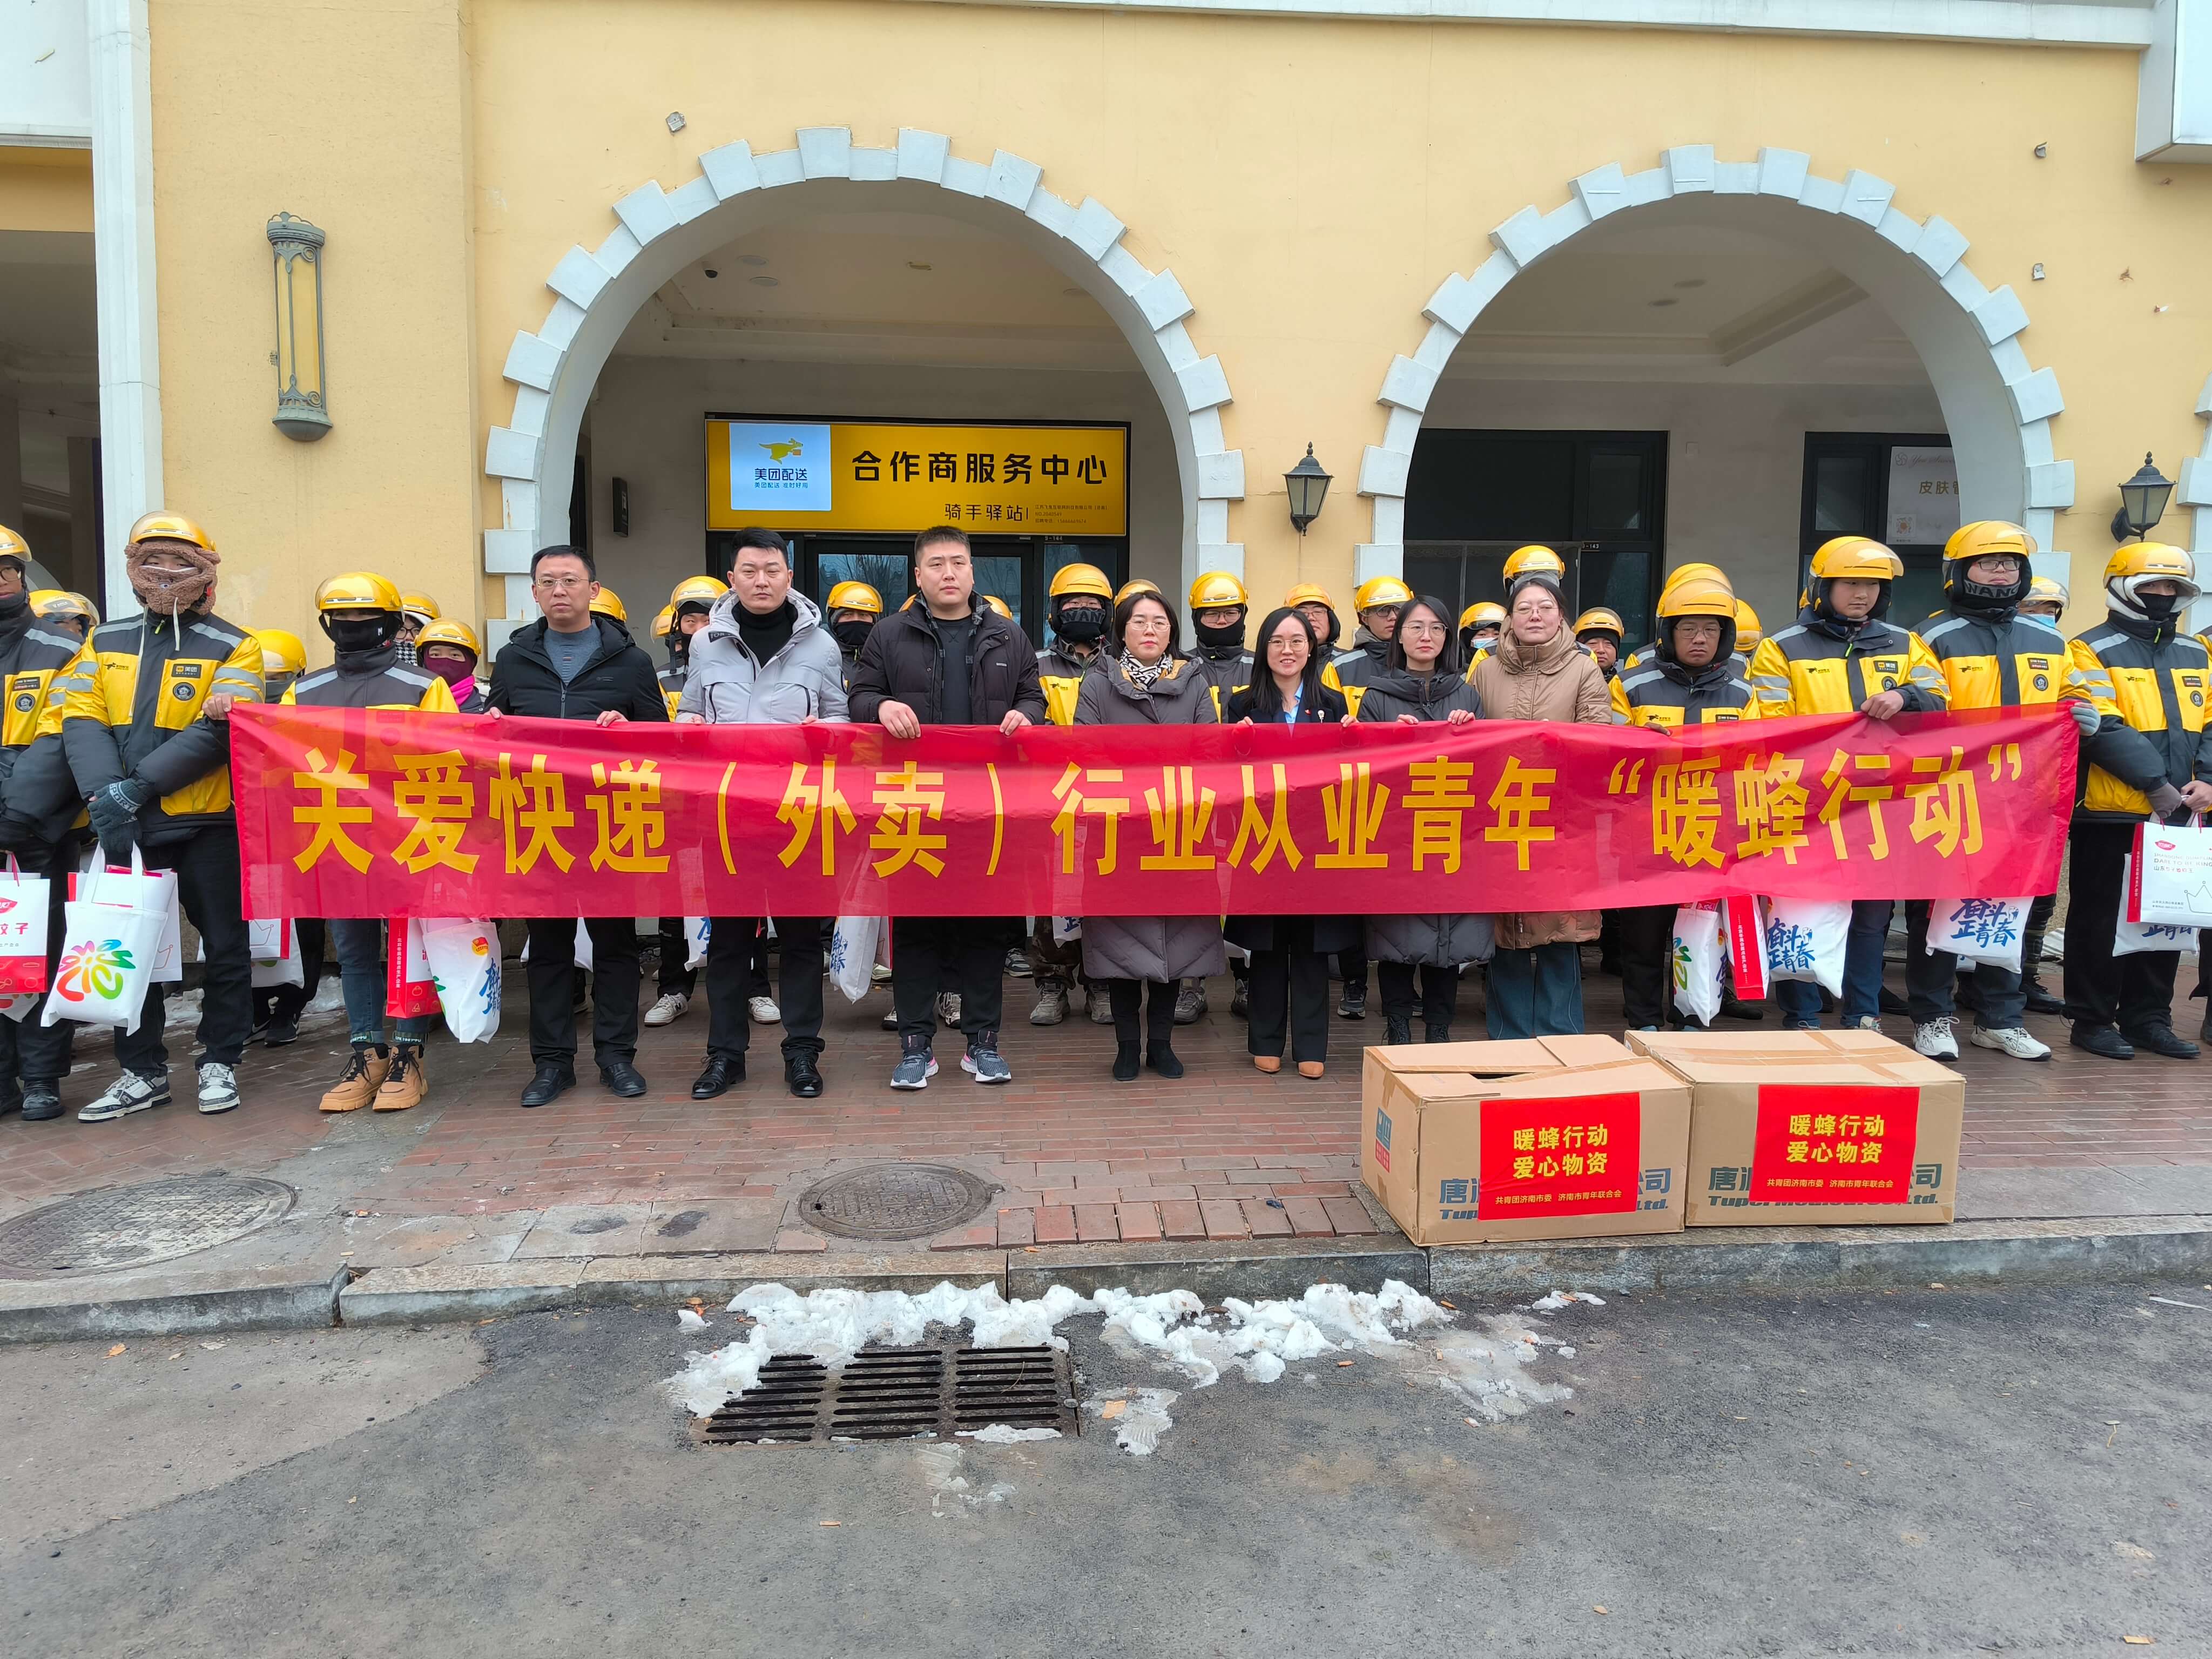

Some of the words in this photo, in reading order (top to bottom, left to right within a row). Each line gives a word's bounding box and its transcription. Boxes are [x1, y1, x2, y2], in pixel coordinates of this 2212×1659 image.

[754, 468, 808, 481] 美团配送
[852, 450, 1107, 485] 合作商服务中心
[944, 503, 1023, 522] 骑手驿站
[1768, 917, 1802, 952] 奋斗
[1951, 918, 2017, 948] 正青春
[1768, 941, 1815, 973] 正青春
[1513, 1123, 1608, 1151] 暖蜂行动
[1789, 1114, 1885, 1137] 暖蜂行动
[1786, 1141, 1883, 1163] 爱心物资
[1513, 1151, 1608, 1179] 爱心物资
[1766, 1178, 1824, 1188] 共青团济南市委
[1829, 1179, 1894, 1188] 济南市青年联合会
[1495, 1193, 1552, 1205] 共青团济南市委
[1557, 1189, 1622, 1202] 济南市青年联合会
